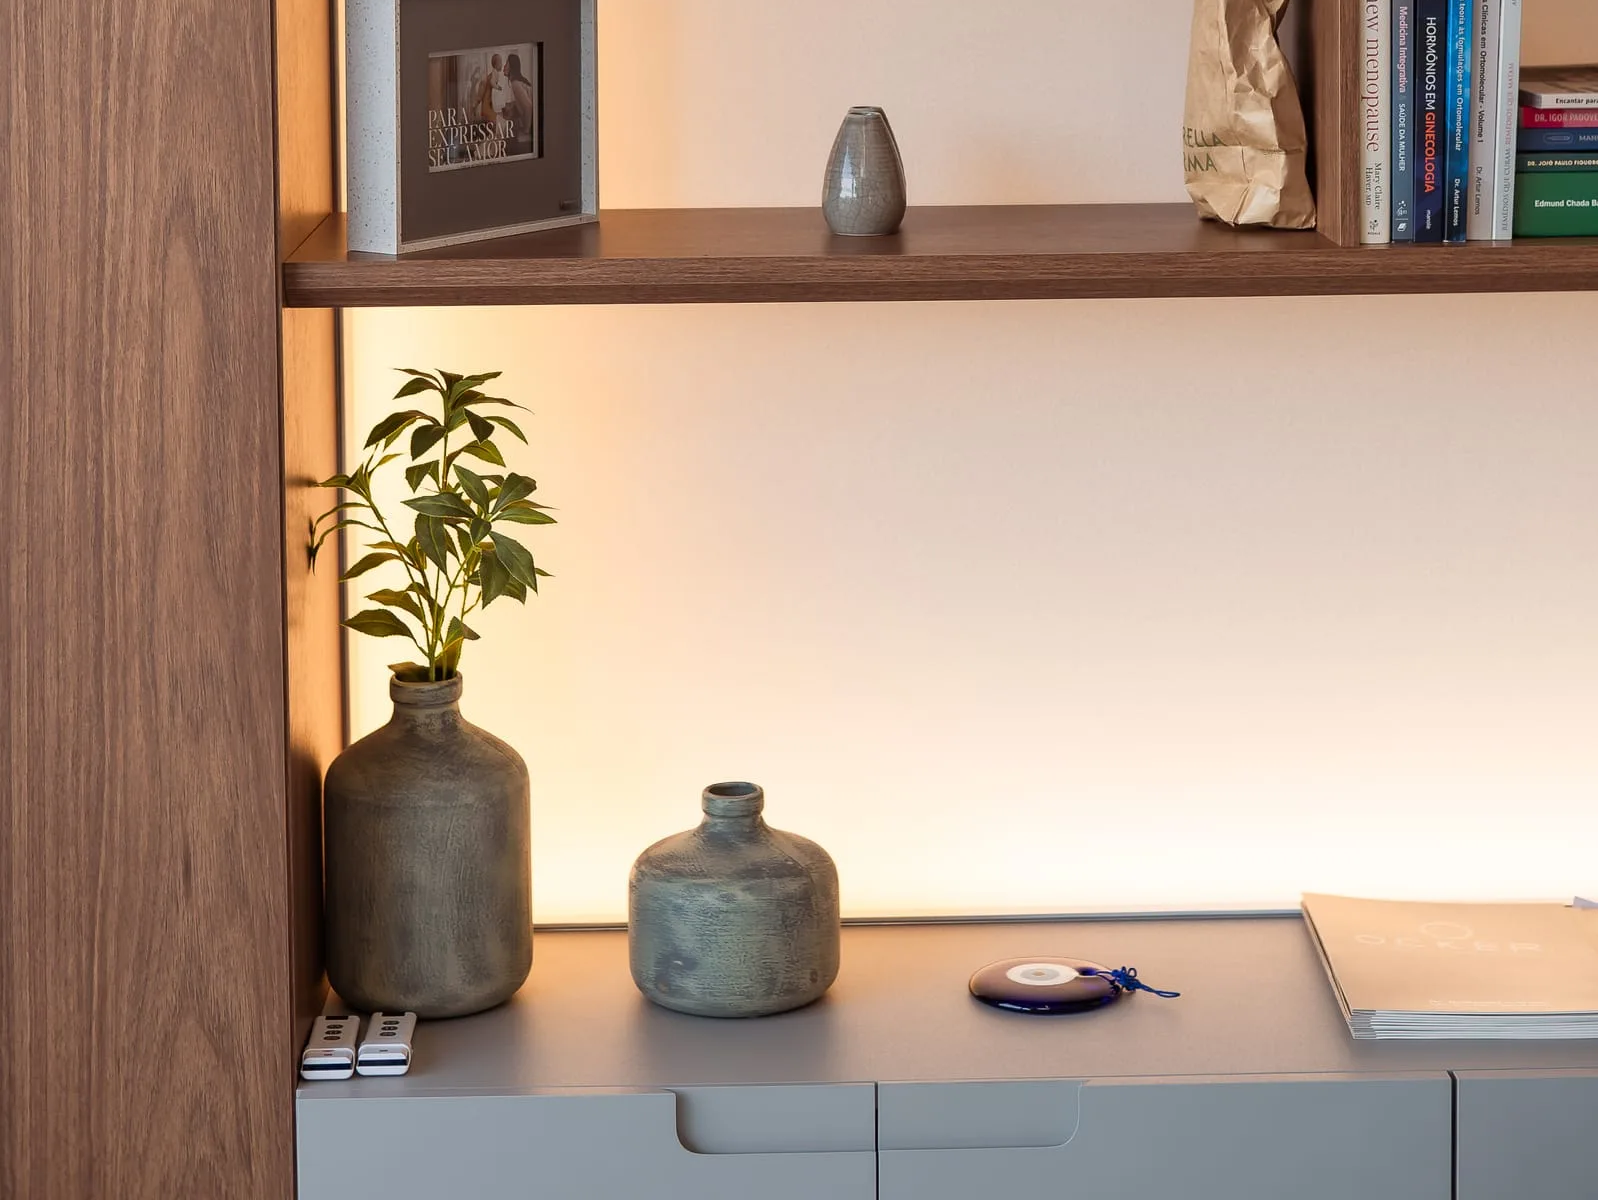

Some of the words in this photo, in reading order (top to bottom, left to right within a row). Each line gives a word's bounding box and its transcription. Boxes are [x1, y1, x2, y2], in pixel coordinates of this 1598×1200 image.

[1400, 6, 1408, 46] Medicina
[1458, 4, 1466, 25] teoria
[1480, 4, 1489, 35] Clínicas
[1425, 17, 1438, 91] HORMÔNIOS
[1480, 36, 1487, 49] em
[1397, 47, 1408, 93] Integrativa
[1456, 36, 1465, 82] formulações
[1457, 84, 1463, 96] em
[1478, 50, 1487, 105] Ortomolecular
[1361, 38, 1379, 153] menopause
[1425, 92, 1436, 110] EM
[428, 107, 469, 129] PARA
[1398, 103, 1407, 128] SAÚDE
[1455, 97, 1464, 151] Ortomolecular
[1477, 109, 1485, 138] Volume
[1534, 112, 1547, 122] DR.
[1549, 112, 1568, 122] IGOR
[428, 120, 516, 148] EXPRESSAR
[1398, 129, 1406, 140] DA
[428, 146, 456, 167] SEU
[463, 140, 508, 163] AMOR
[1398, 141, 1406, 172] MULHER
[1424, 112, 1436, 193] GINECOLOGIA
[1373, 163, 1382, 184] Mary
[1365, 194, 1372, 206] MD
[1374, 185, 1383, 210] Claire
[1534, 199, 1565, 207] Edmund
[1566, 199, 1590, 207] Chada
[1452, 206, 1460, 227] Lemos
